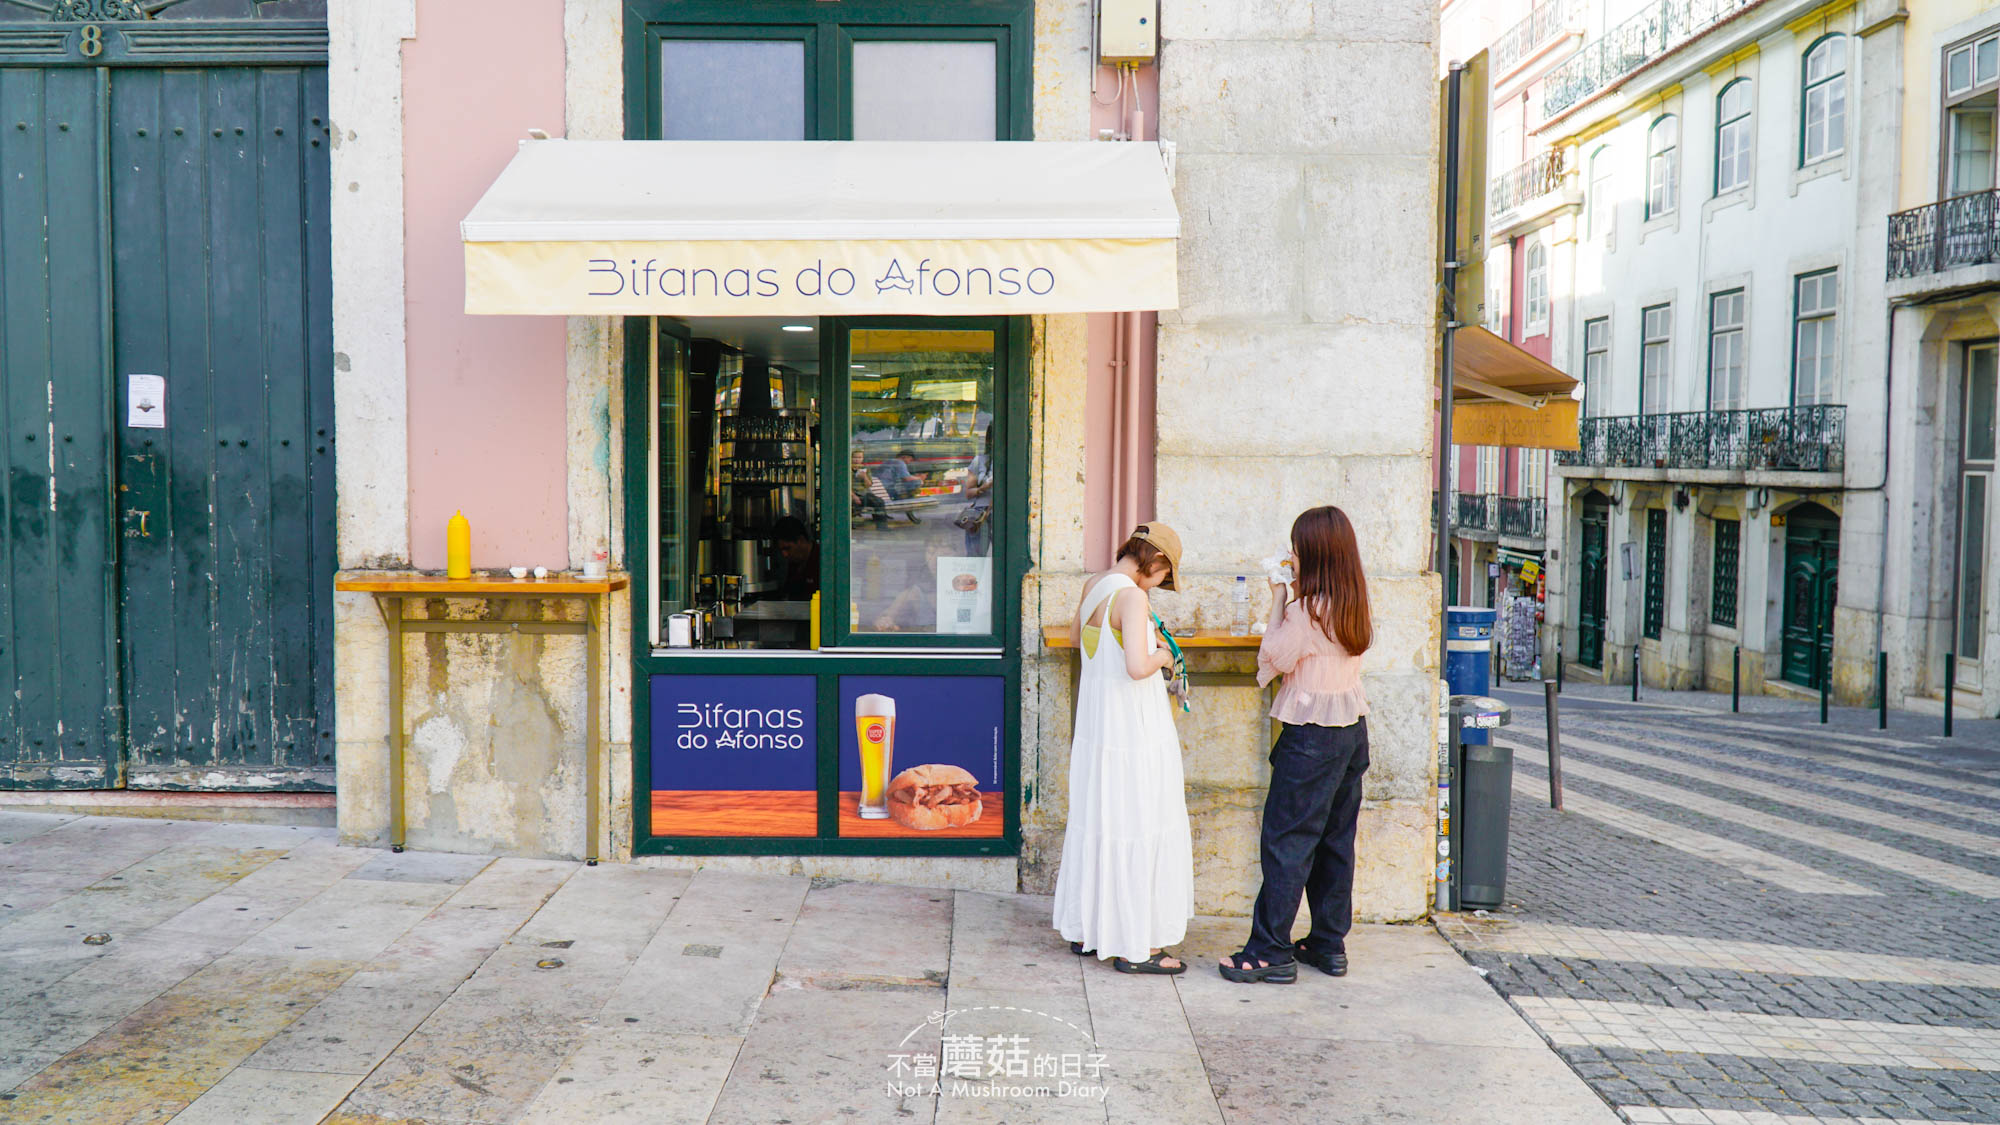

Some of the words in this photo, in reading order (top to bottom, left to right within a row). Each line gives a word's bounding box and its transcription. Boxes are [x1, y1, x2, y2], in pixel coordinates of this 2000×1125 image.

[79, 24, 103, 57] 8
[588, 258, 780, 297] Bifanas
[795, 259, 856, 297] do
[875, 258, 1056, 296] Afonso
[677, 702, 804, 729] Bifanas
[676, 730, 708, 749] do
[715, 729, 804, 749] Afonso
